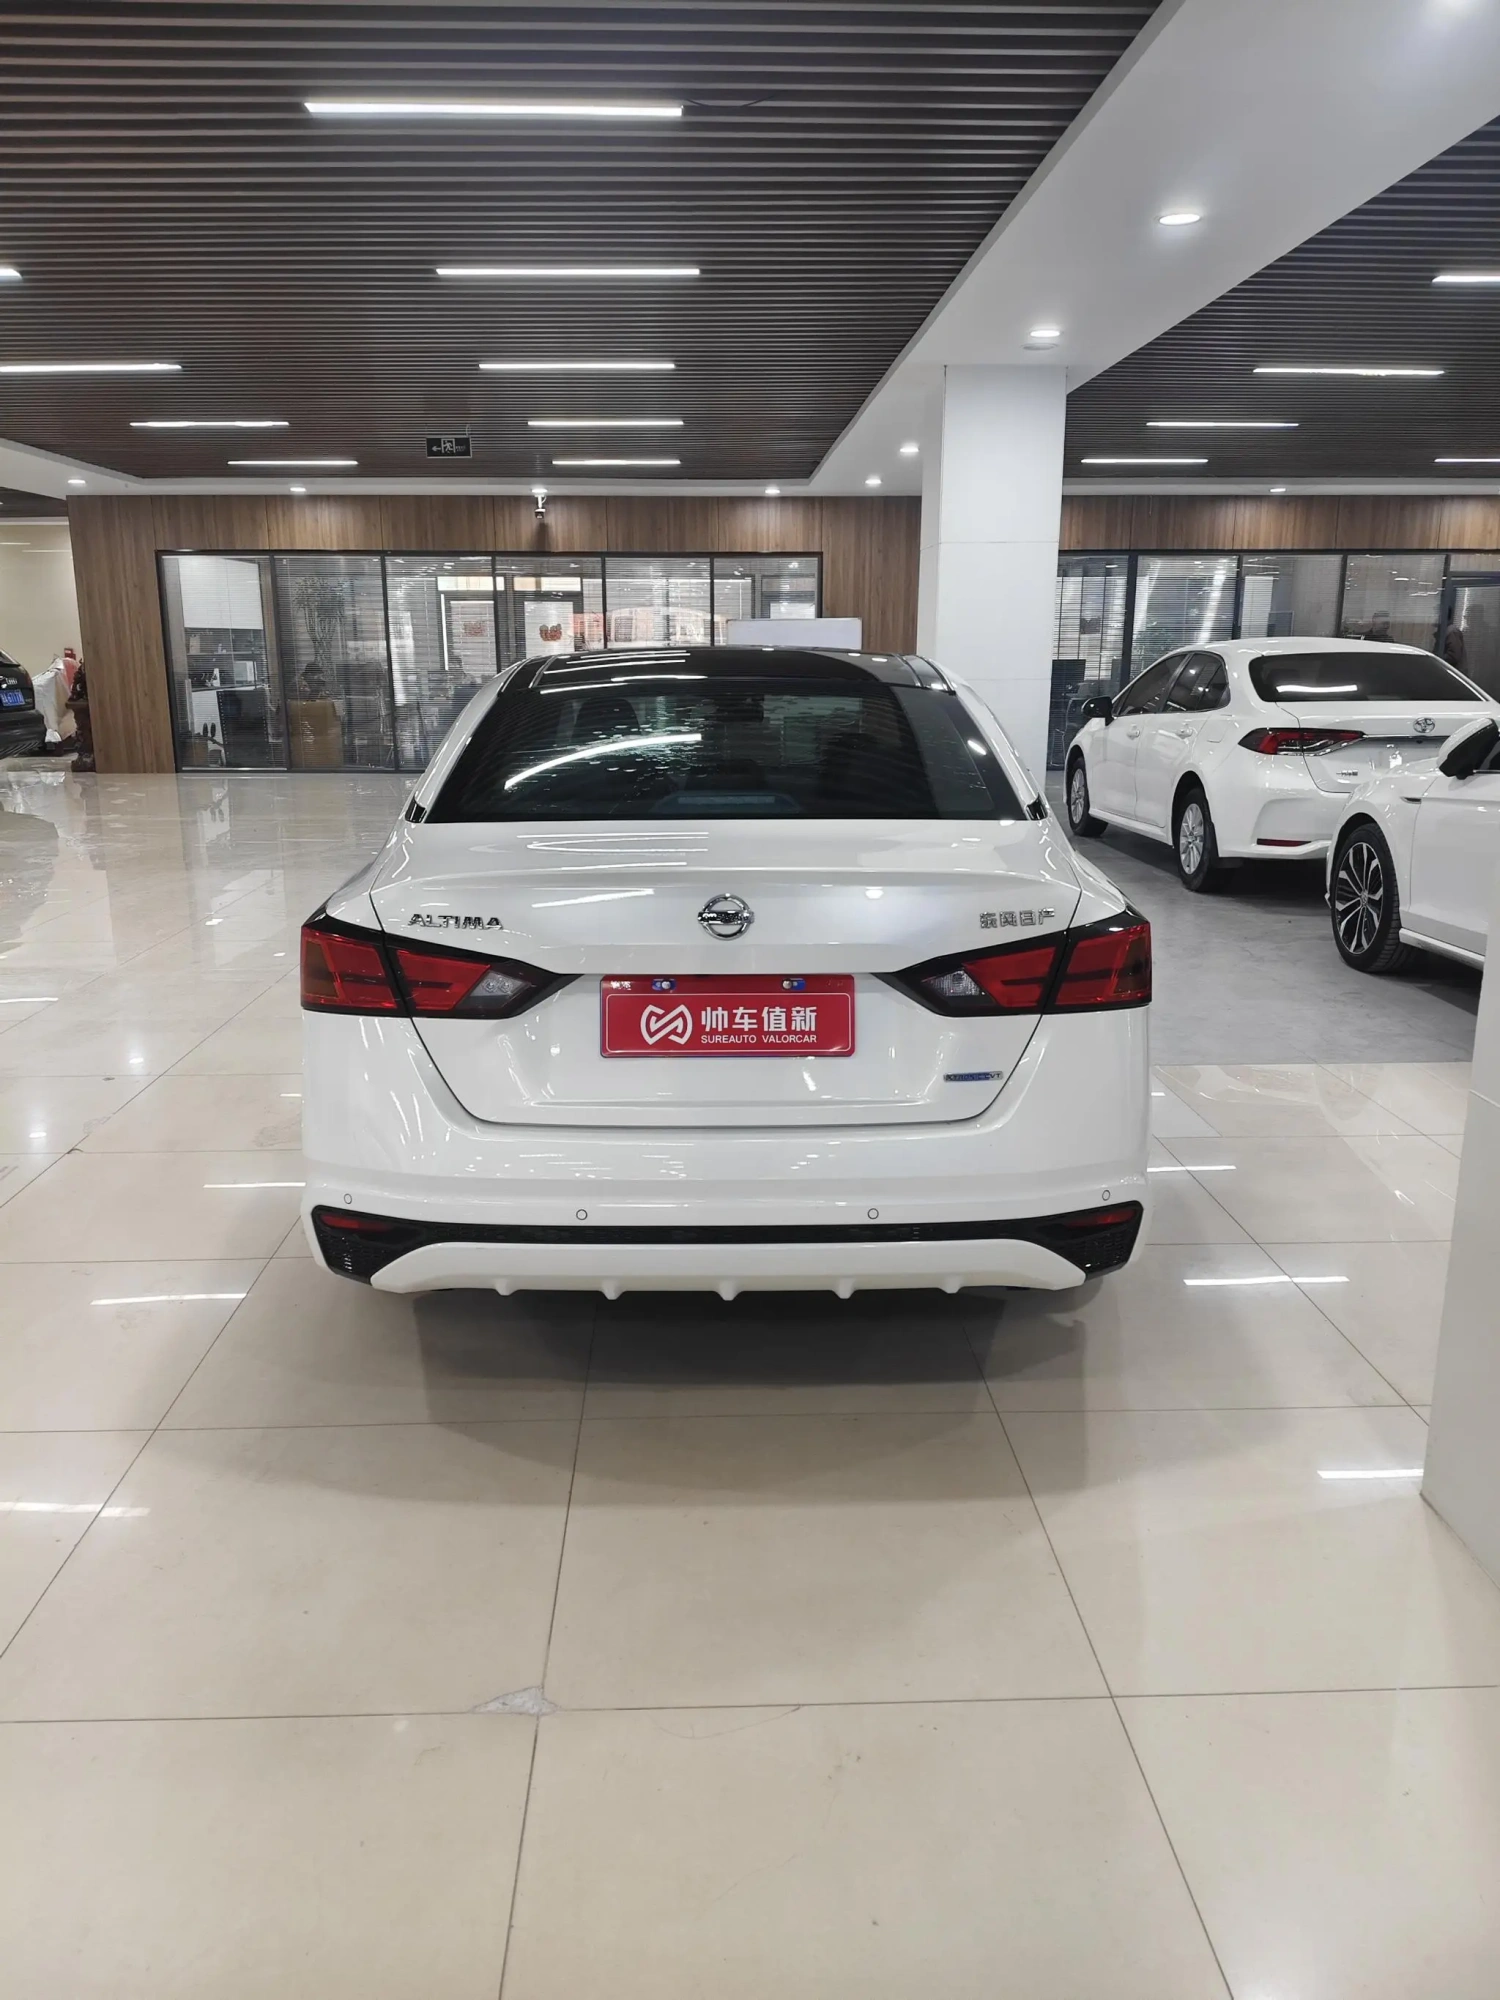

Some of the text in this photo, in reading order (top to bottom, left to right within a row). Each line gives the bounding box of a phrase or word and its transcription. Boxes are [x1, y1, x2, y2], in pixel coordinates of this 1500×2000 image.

[407, 914, 503, 930] ALTIMA
[979, 908, 1055, 928] 东风日产
[701, 1006, 817, 1032] 帅车值新
[701, 1034, 817, 1044] SUREAUTO VALORCAR
